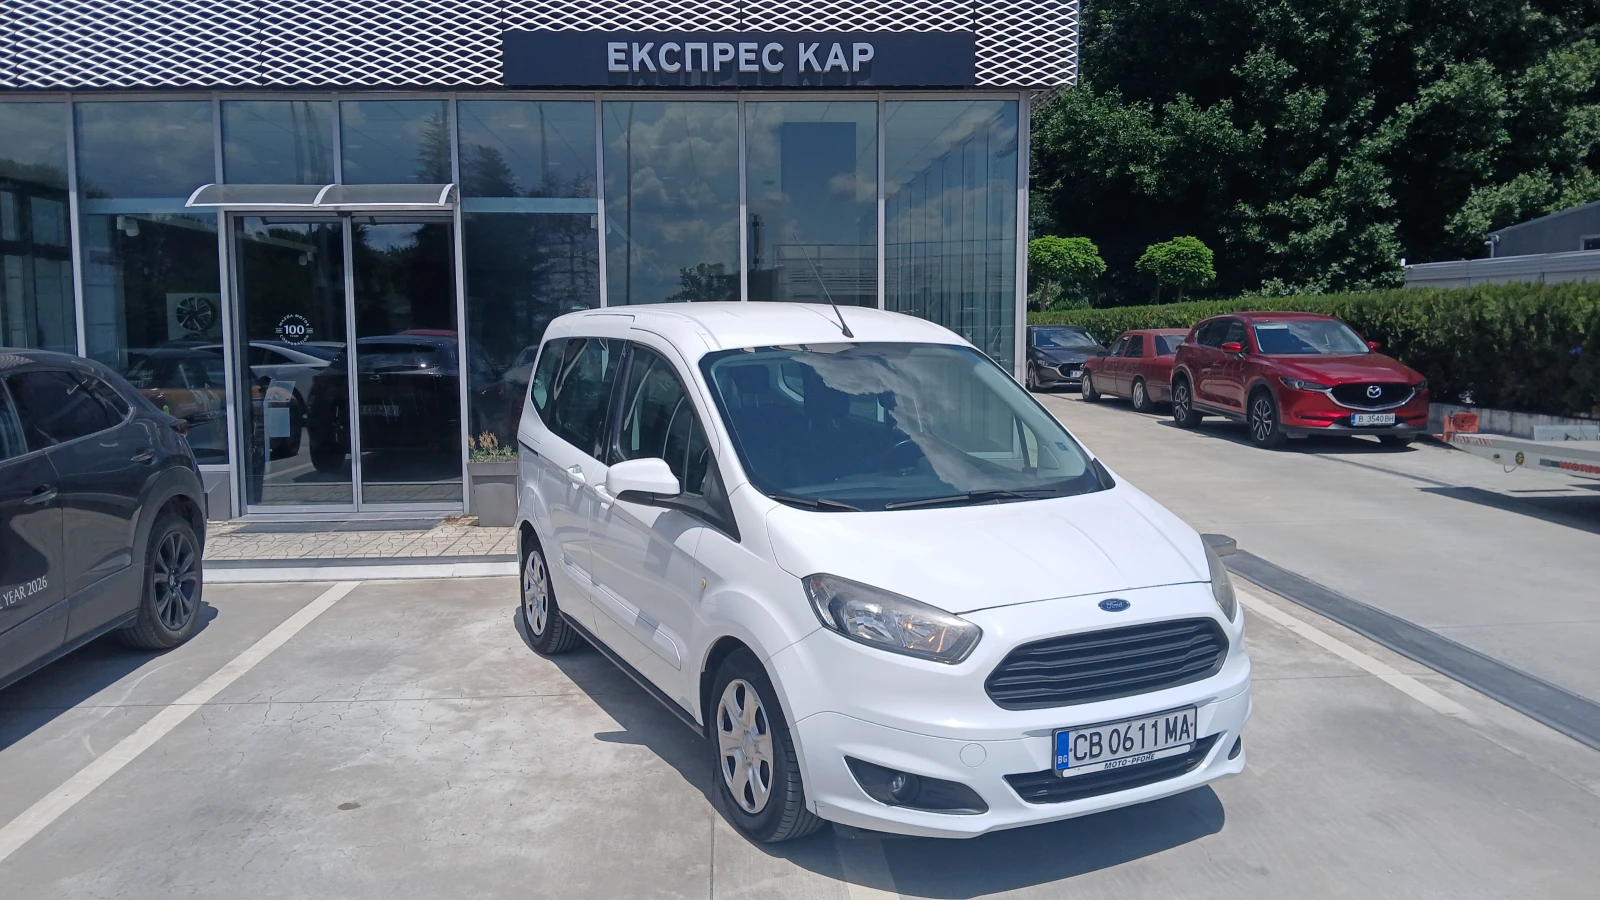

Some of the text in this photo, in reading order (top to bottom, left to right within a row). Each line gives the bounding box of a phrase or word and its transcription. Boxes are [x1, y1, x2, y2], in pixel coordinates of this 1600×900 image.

[607, 41, 875, 73] ЕКСПРЕС КАР
[284, 325, 305, 335] 100
[3, 575, 48, 606] YEAR 2026
[1073, 714, 1191, 761] CB 0611 MA
[1057, 754, 1068, 765] BG
[1104, 753, 1156, 770] MOTO-PFOHE
